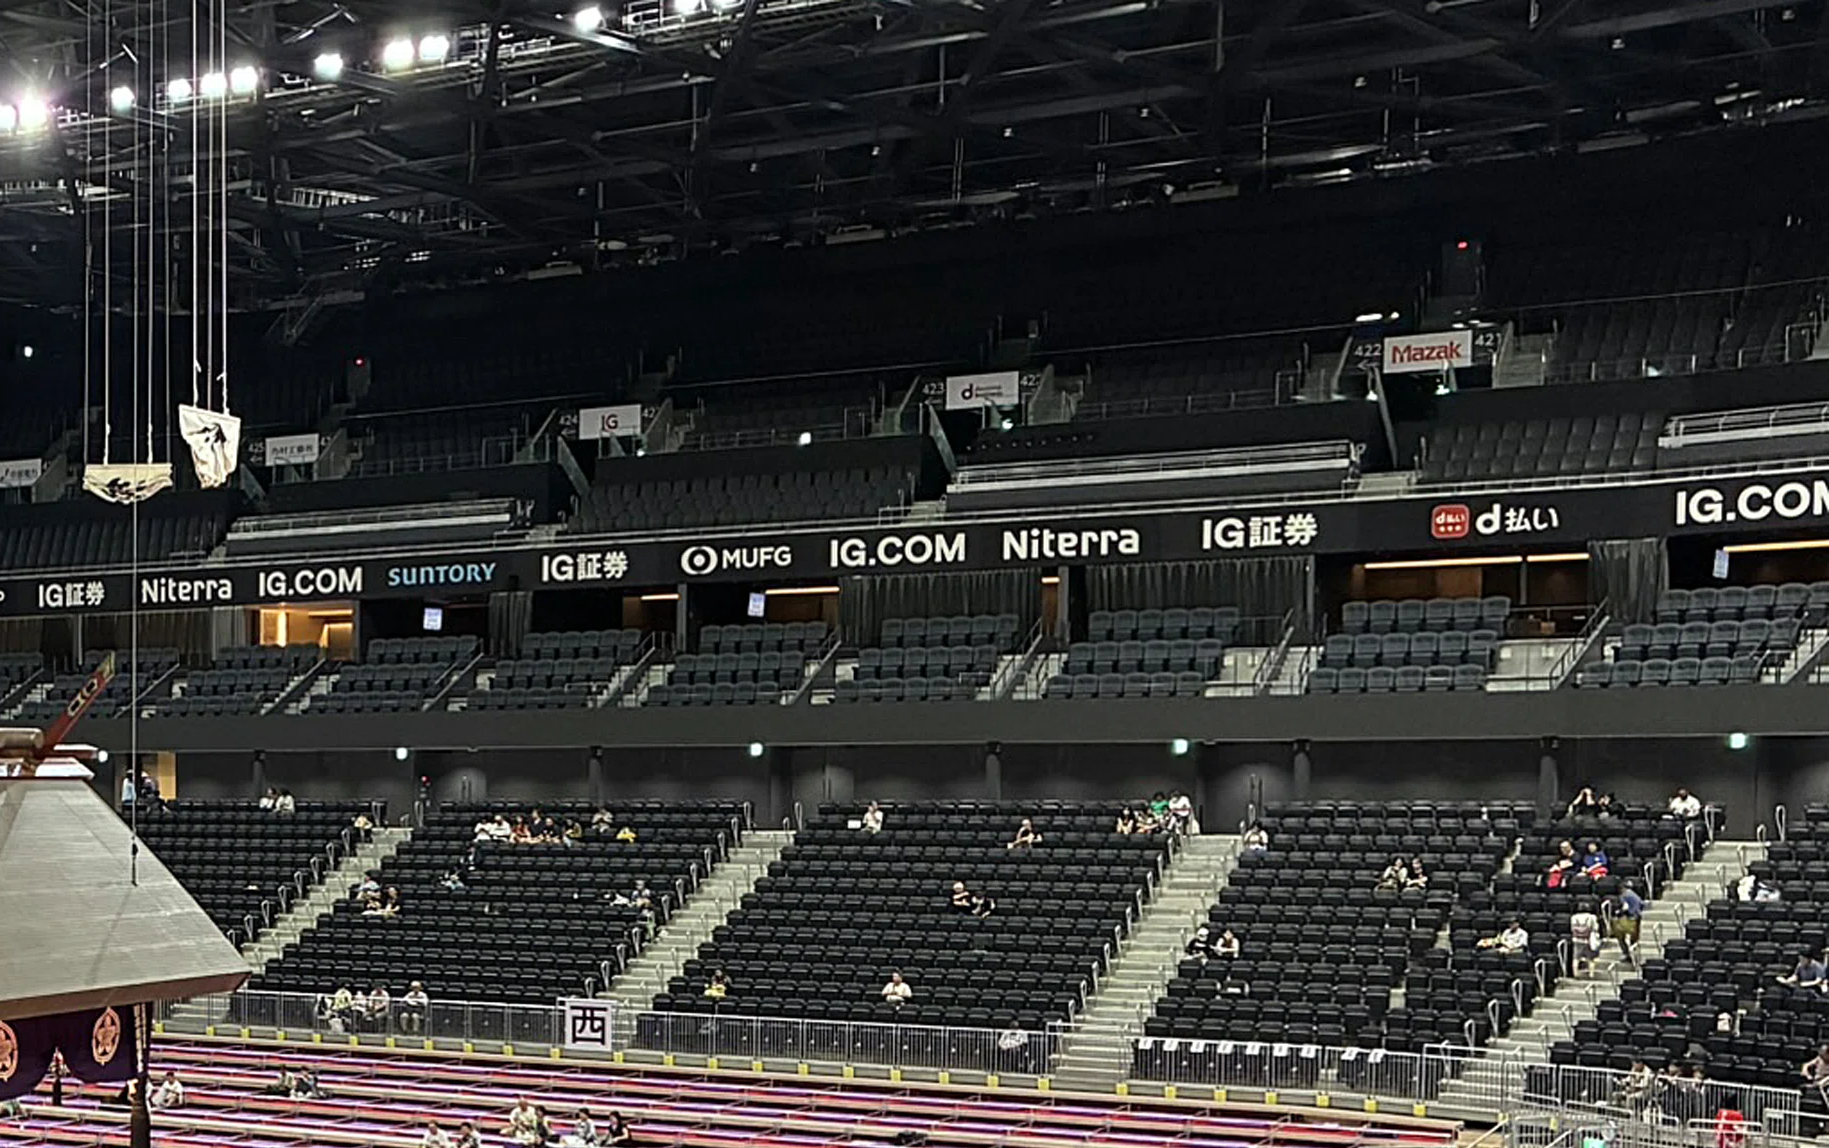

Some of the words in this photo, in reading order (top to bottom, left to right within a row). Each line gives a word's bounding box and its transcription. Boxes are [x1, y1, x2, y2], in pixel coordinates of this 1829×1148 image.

[1392, 340, 1462, 364] Mazak
[601, 414, 618, 431] IG
[1201, 513, 1318, 549] IG証券
[1475, 503, 1559, 535] d払い
[722, 546, 792, 569] MUFG
[830, 532, 967, 567] IG.COM
[1003, 528, 1140, 561] Niterra
[542, 551, 629, 582] IG証券
[38, 580, 105, 608] IG証券
[141, 577, 233, 604] Niterra
[258, 567, 364, 597] IG.COM
[570, 1005, 608, 1045] 西
